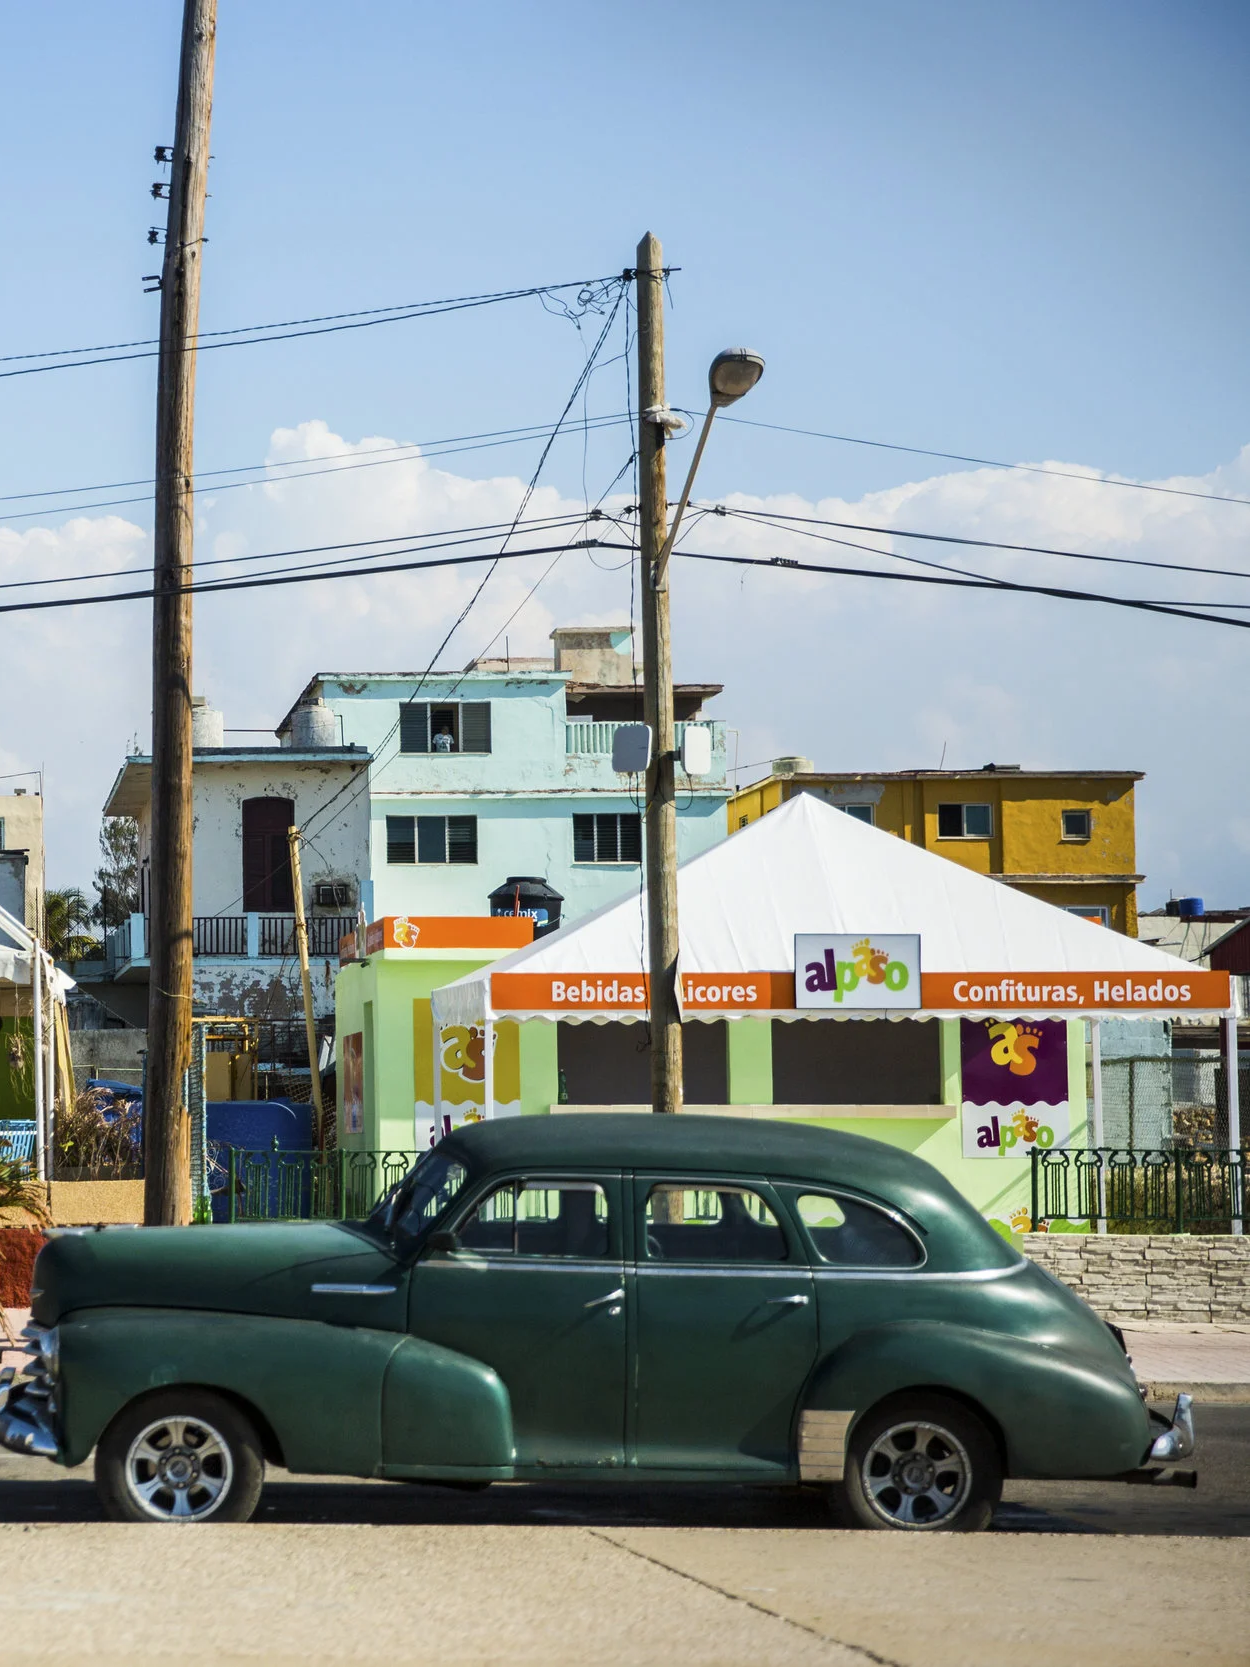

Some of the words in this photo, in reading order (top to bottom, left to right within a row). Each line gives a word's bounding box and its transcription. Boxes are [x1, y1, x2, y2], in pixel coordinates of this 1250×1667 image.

[805, 942, 909, 1003] alpaso
[551, 980, 646, 1003] Bebidas
[682, 980, 758, 1003] icores
[953, 979, 1085, 1005] Confituras,
[1094, 979, 1192, 1002] Helados
[977, 1110, 1054, 1156] alpaso
